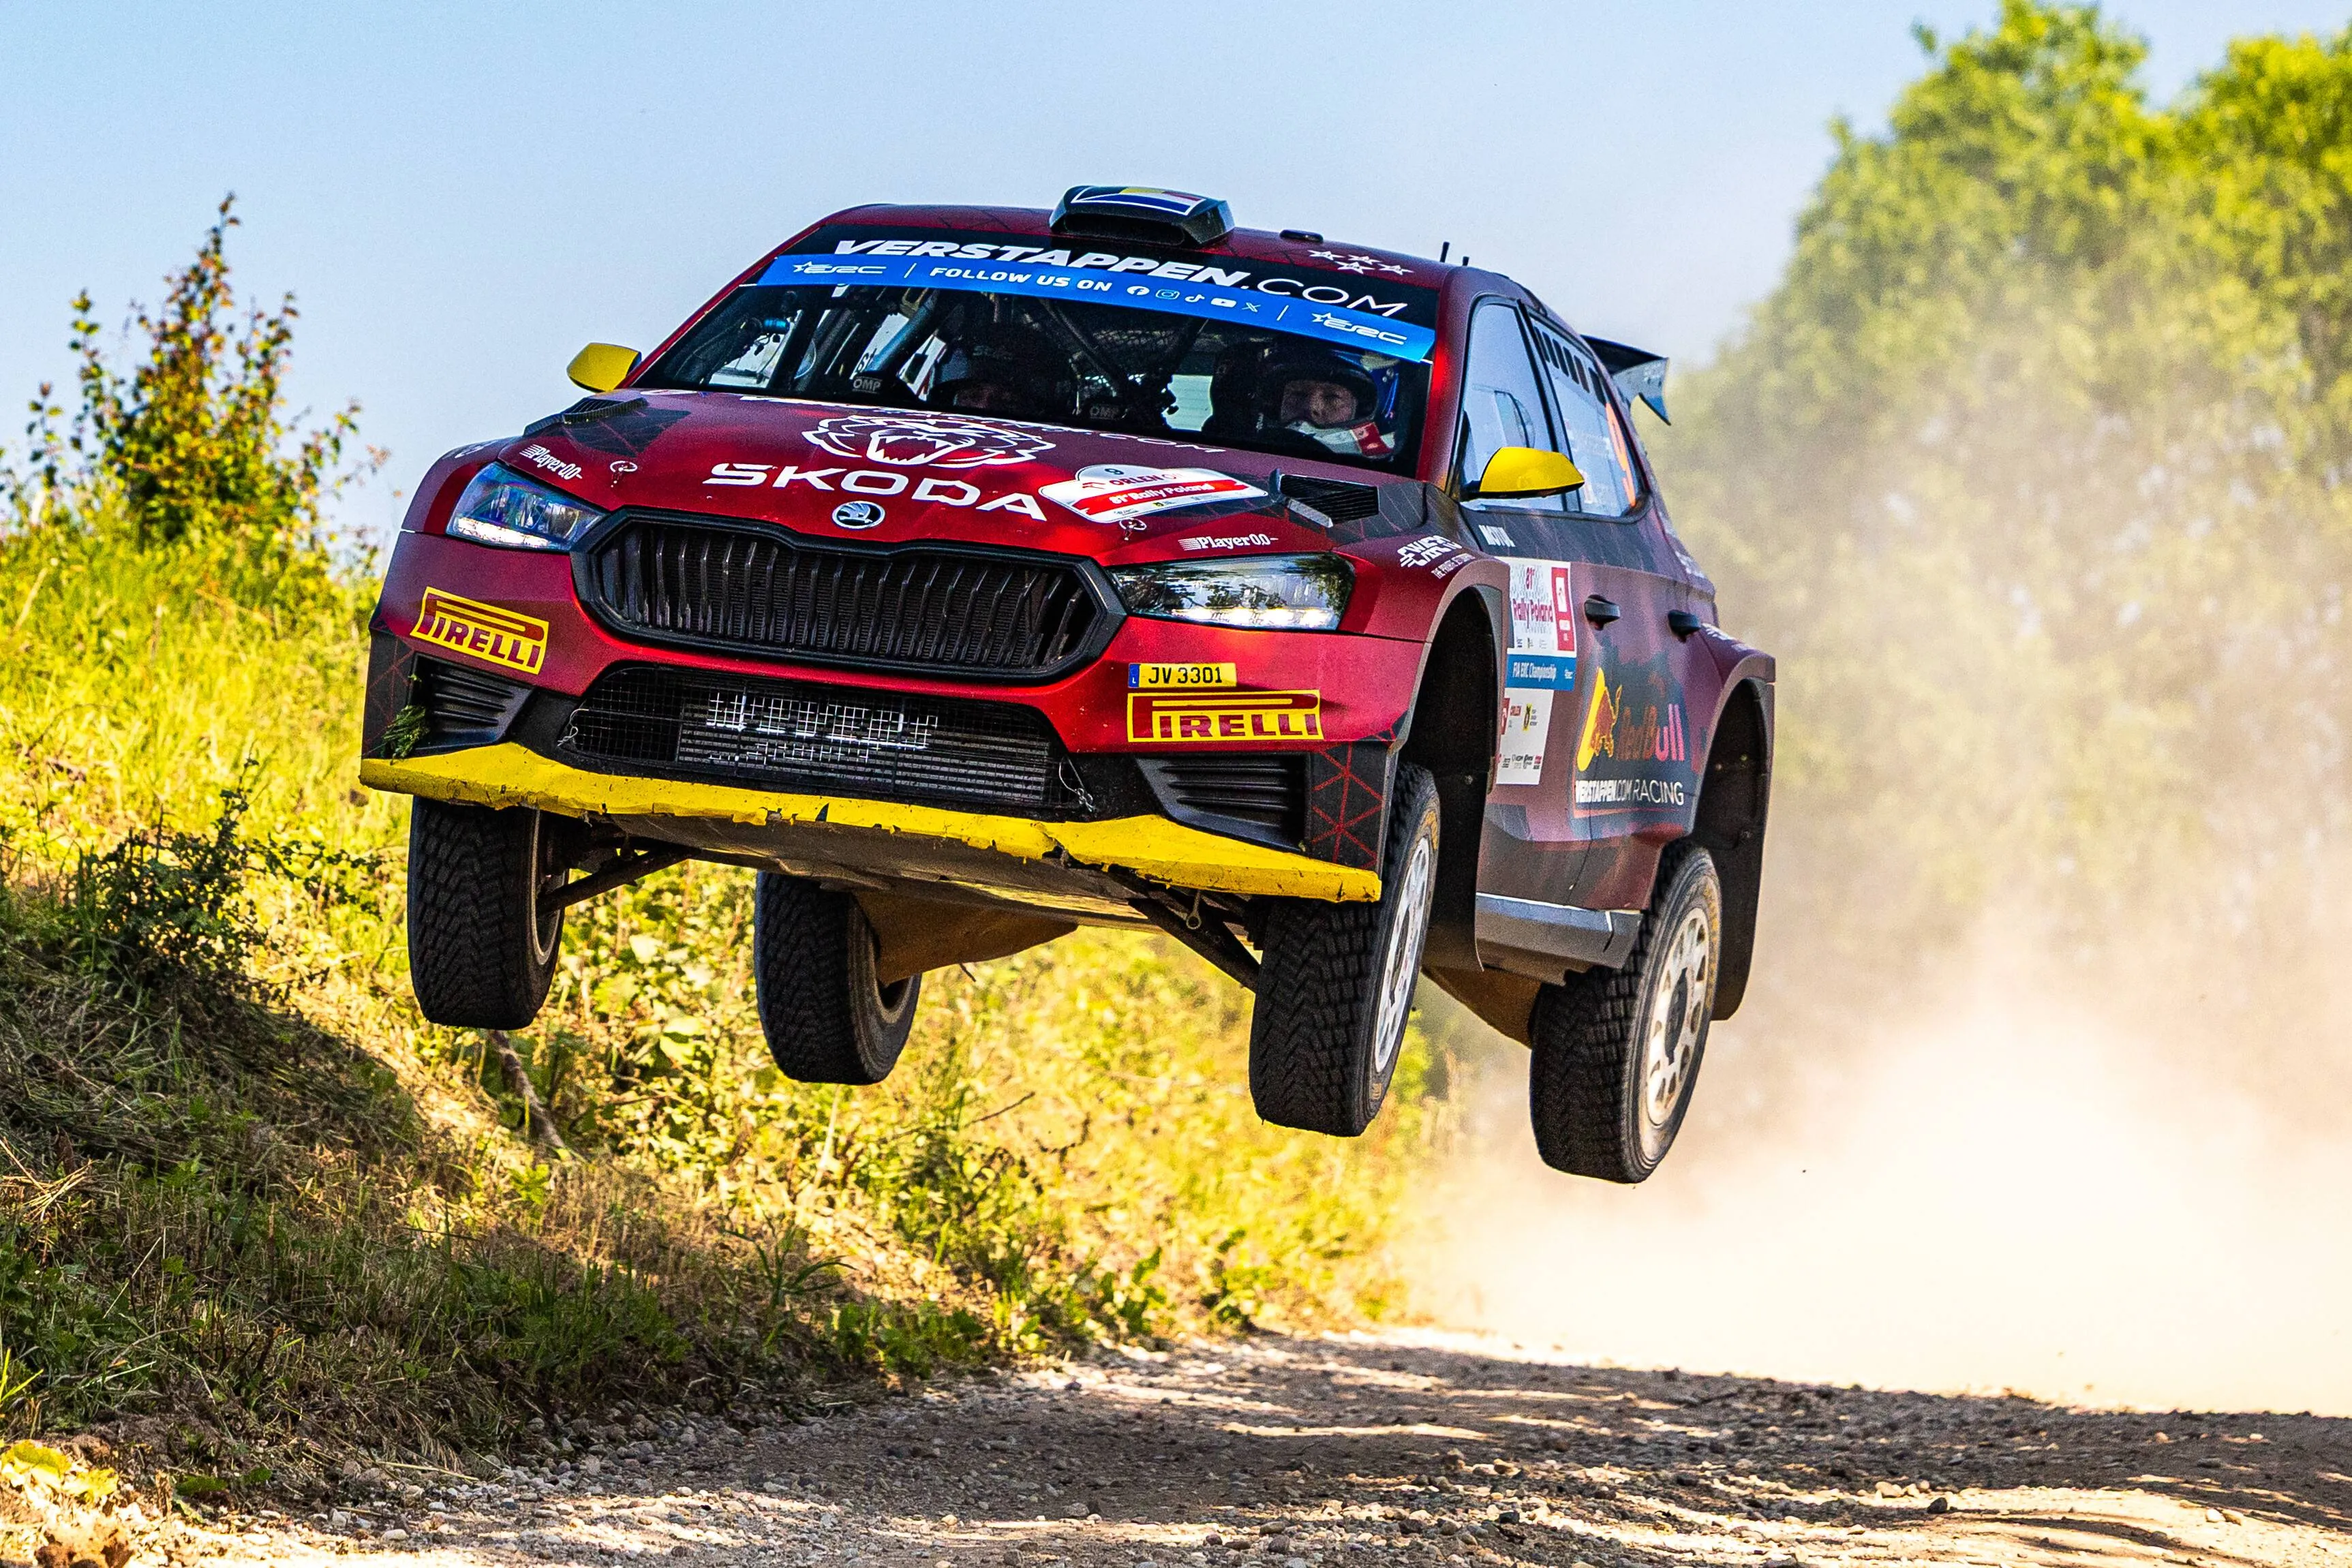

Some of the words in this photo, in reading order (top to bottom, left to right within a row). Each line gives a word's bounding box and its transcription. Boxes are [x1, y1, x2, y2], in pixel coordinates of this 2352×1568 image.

[834, 240, 1408, 317] VERSTAPPEN.COM
[930, 267, 1032, 283] FOLLOW
[1036, 275, 1071, 287] US
[1076, 279, 1112, 292] ON
[1109, 474, 1164, 486] ORLEN
[1127, 489, 1167, 500] Rally
[1163, 483, 1215, 495] Poland
[1513, 598, 1530, 629] Rally
[1530, 598, 1553, 623] Poland
[417, 592, 545, 668] PIRELLI
[1148, 666, 1172, 684] JV
[1176, 666, 1223, 683] 3301
[1133, 694, 1319, 738] PIRELLI
[1632, 780, 1684, 805] RACING
